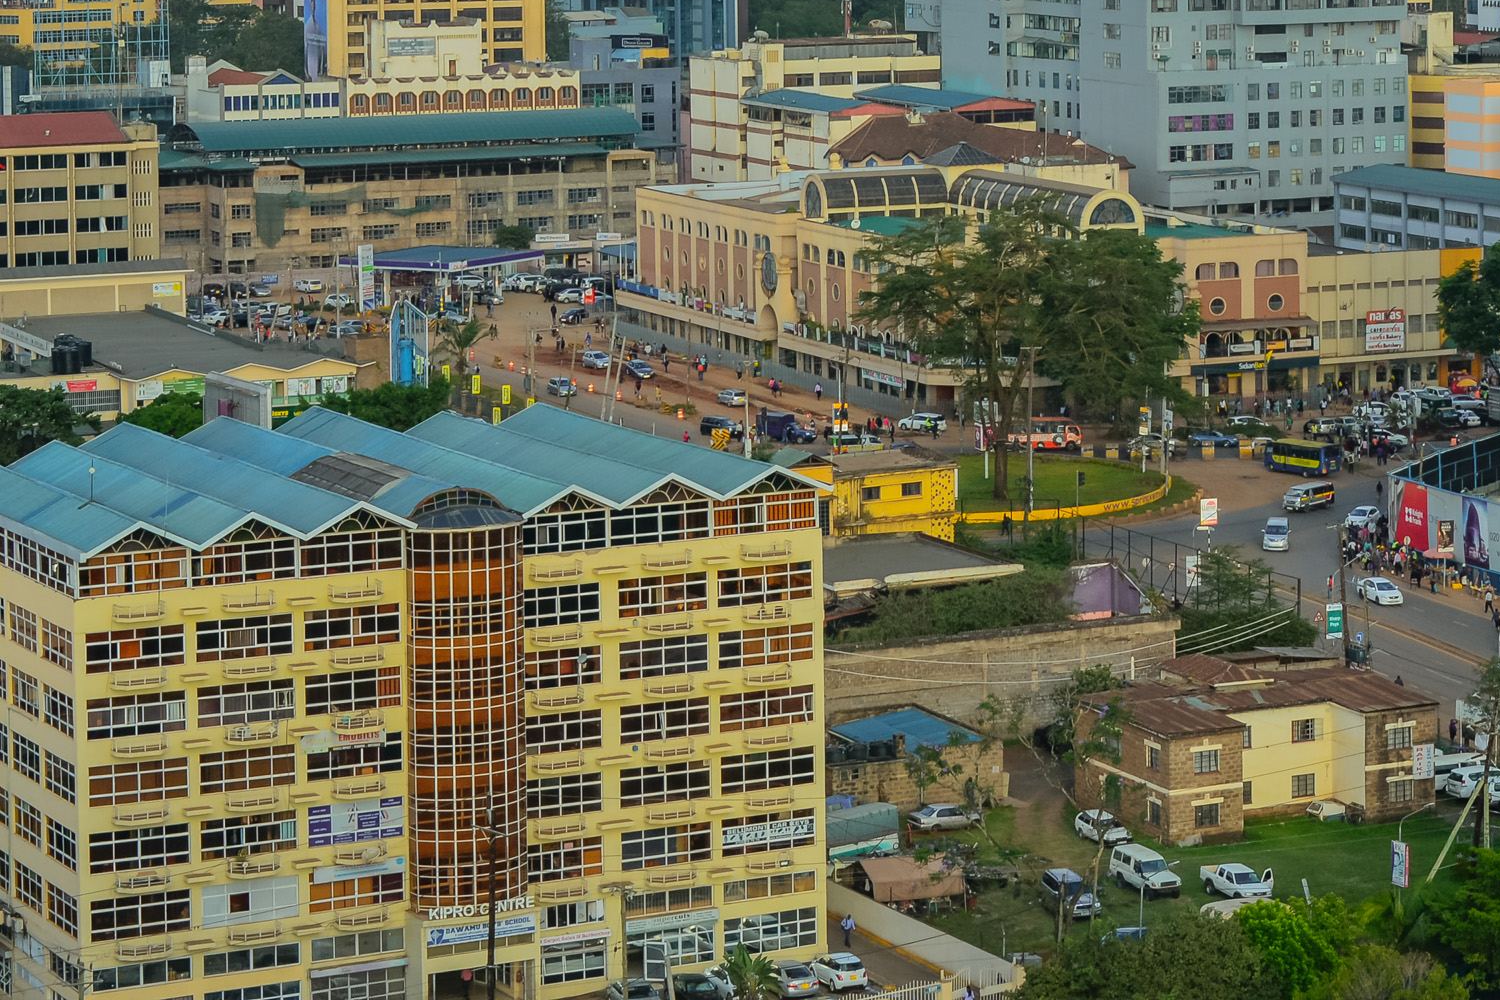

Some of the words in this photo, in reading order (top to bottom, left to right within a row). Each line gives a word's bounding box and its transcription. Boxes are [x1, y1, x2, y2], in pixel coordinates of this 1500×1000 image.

[1370, 306, 1402, 321] naivas
[789, 819, 810, 827] KEYS
[428, 904, 475, 920] KIPRO
[445, 924, 480, 934] DAWAMU
[505, 917, 531, 926] SCHOOL
